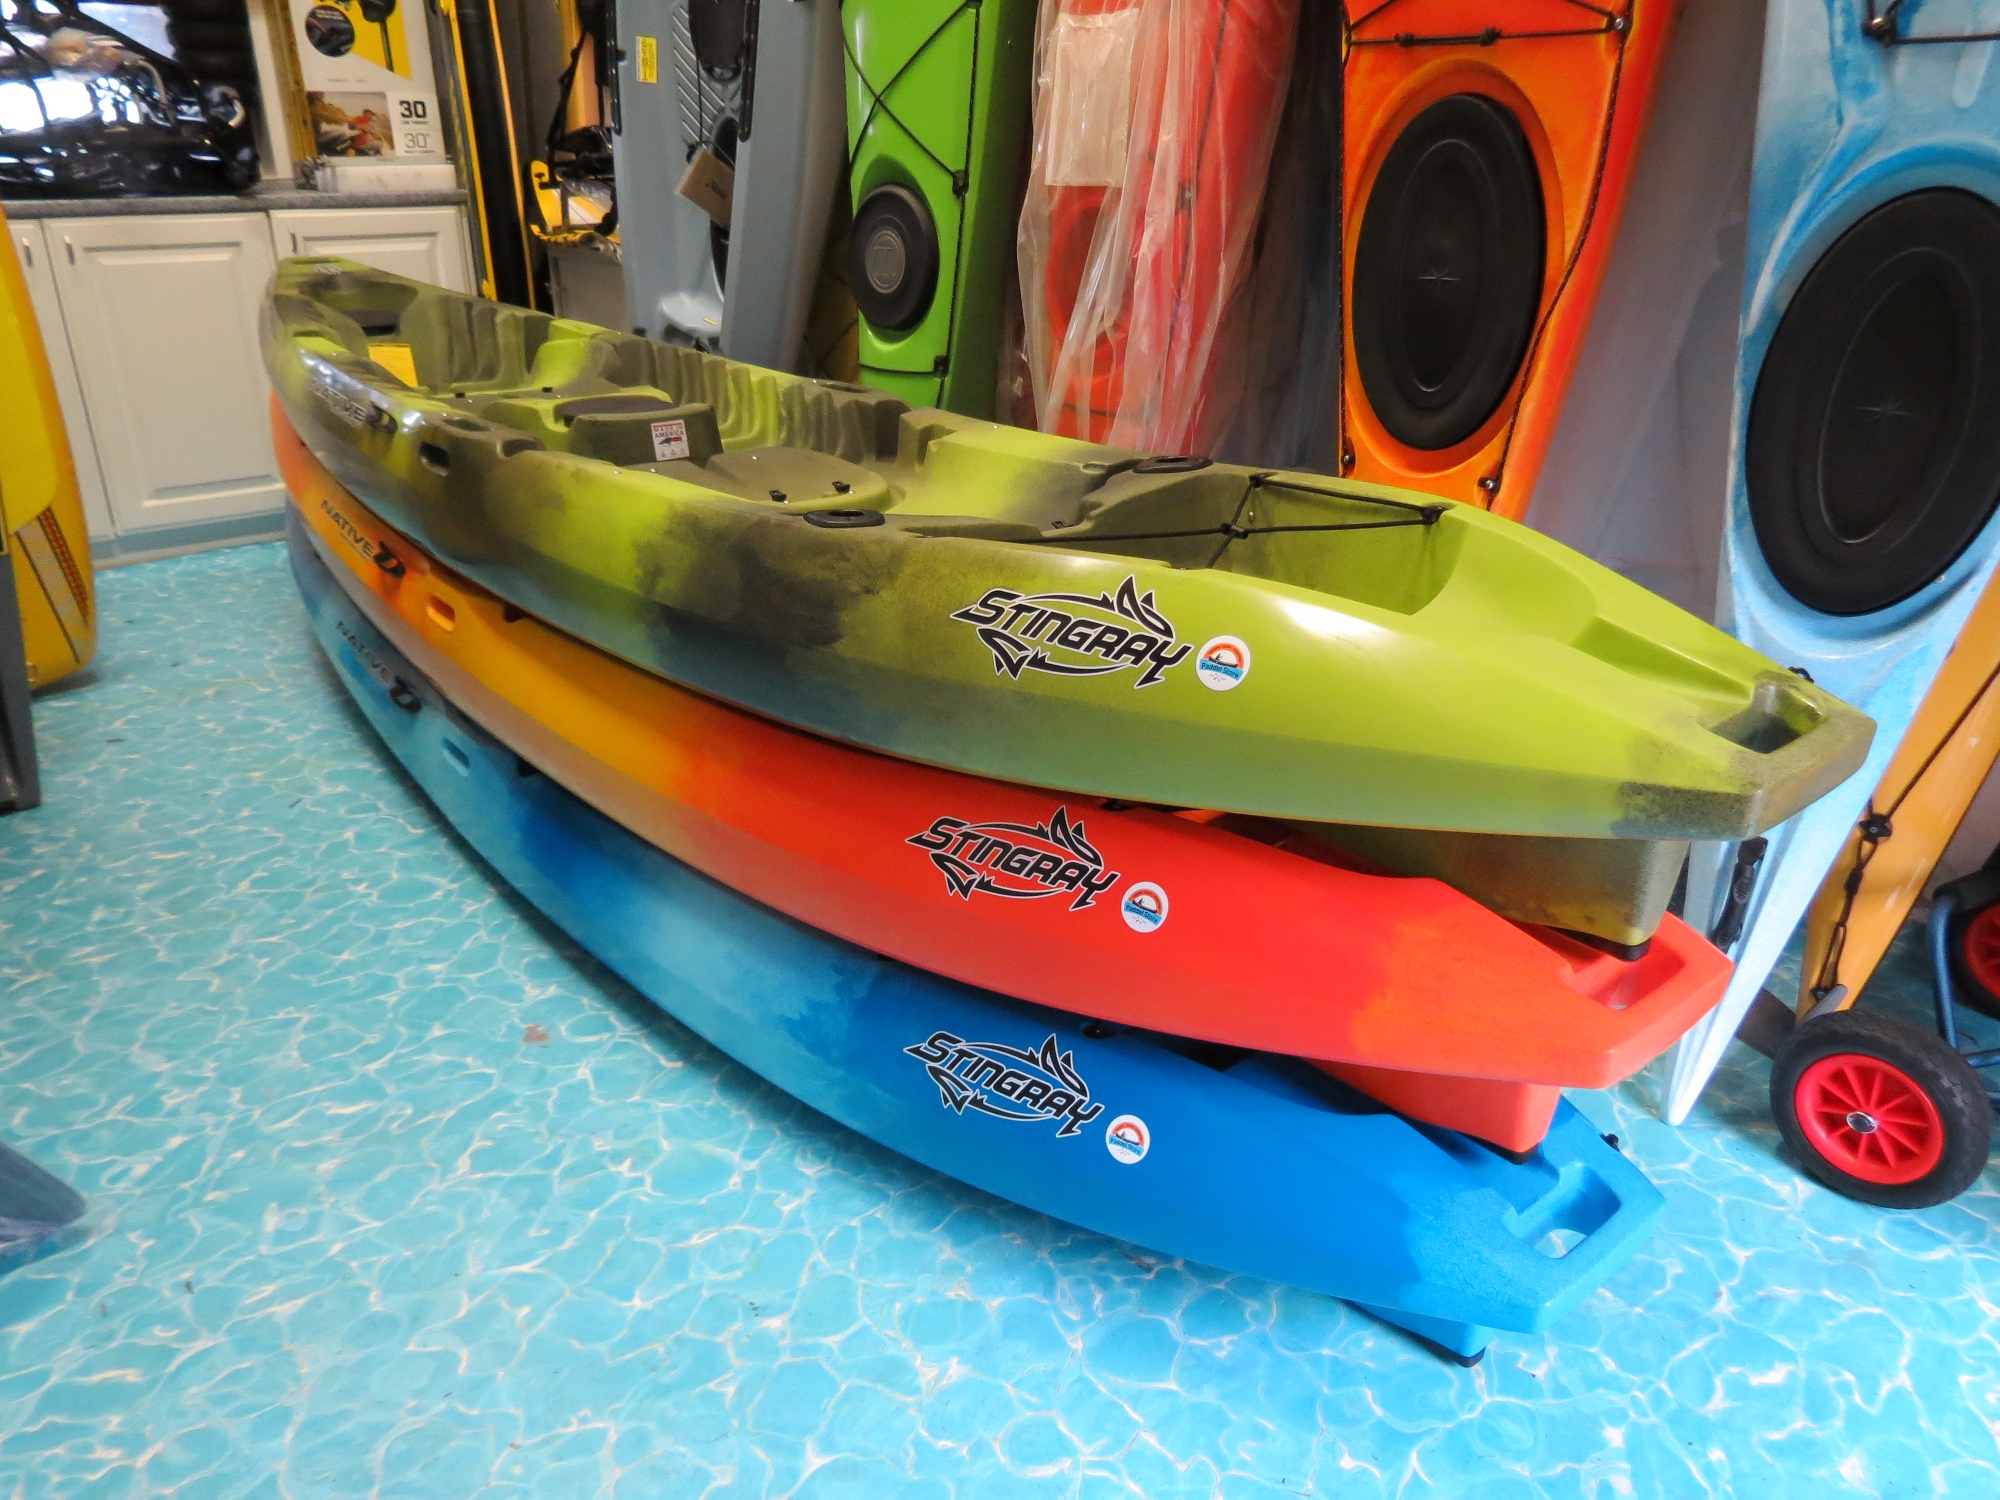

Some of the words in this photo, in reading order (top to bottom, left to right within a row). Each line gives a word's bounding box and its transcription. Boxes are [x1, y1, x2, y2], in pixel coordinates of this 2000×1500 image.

[399, 100, 427, 119] 30
[321, 499, 375, 558] NATIVE
[336, 620, 392, 684] NATIVE
[950, 588, 1195, 689] STINGRAY
[1201, 662, 1222, 673] Paddel
[1222, 667, 1239, 679] Store
[905, 815, 1122, 912] STINGRAY
[1125, 904, 1144, 916] Paddel
[1143, 911, 1159, 924] Store
[903, 1030, 1106, 1138] STINGRAY
